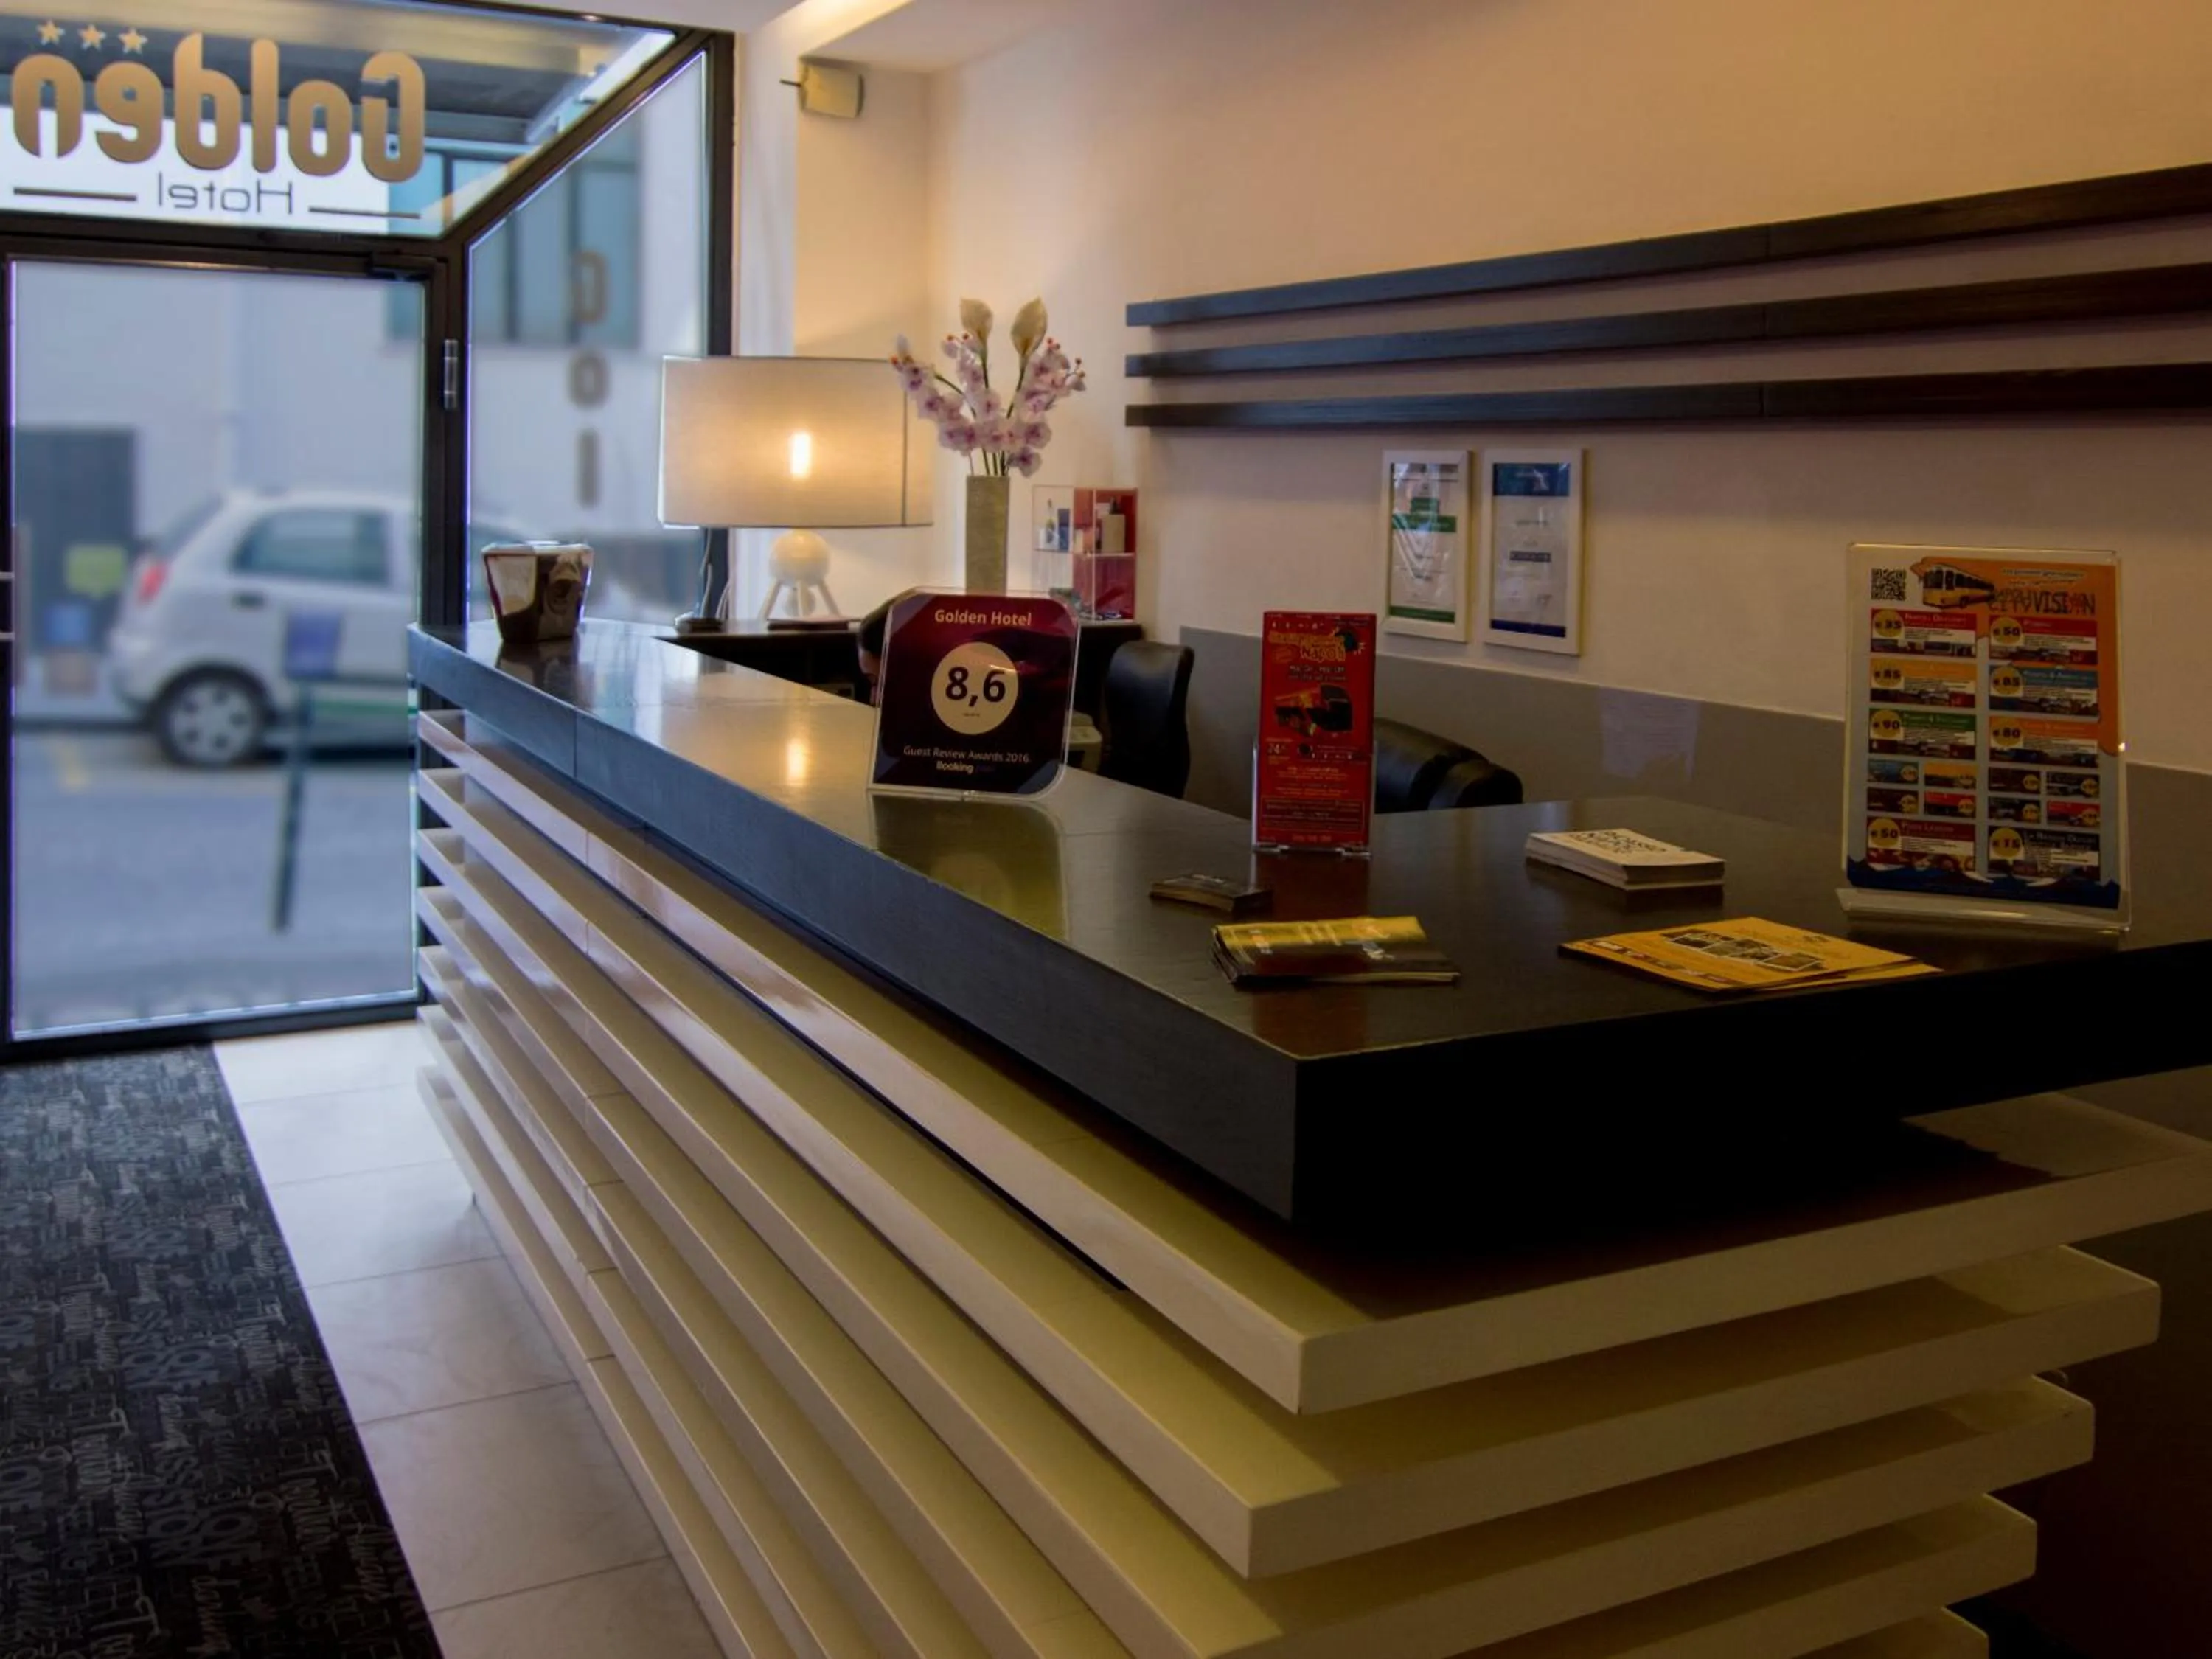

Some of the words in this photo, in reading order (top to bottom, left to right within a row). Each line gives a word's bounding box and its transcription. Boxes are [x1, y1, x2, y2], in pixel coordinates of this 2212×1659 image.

[934, 608, 987, 625] Golden
[990, 611, 1032, 626] Hotel
[945, 667, 1006, 707] 8,6
[903, 745, 931, 757] Guest
[933, 747, 965, 759] Review
[968, 750, 1004, 762] Awards
[1005, 752, 1030, 764] 2016
